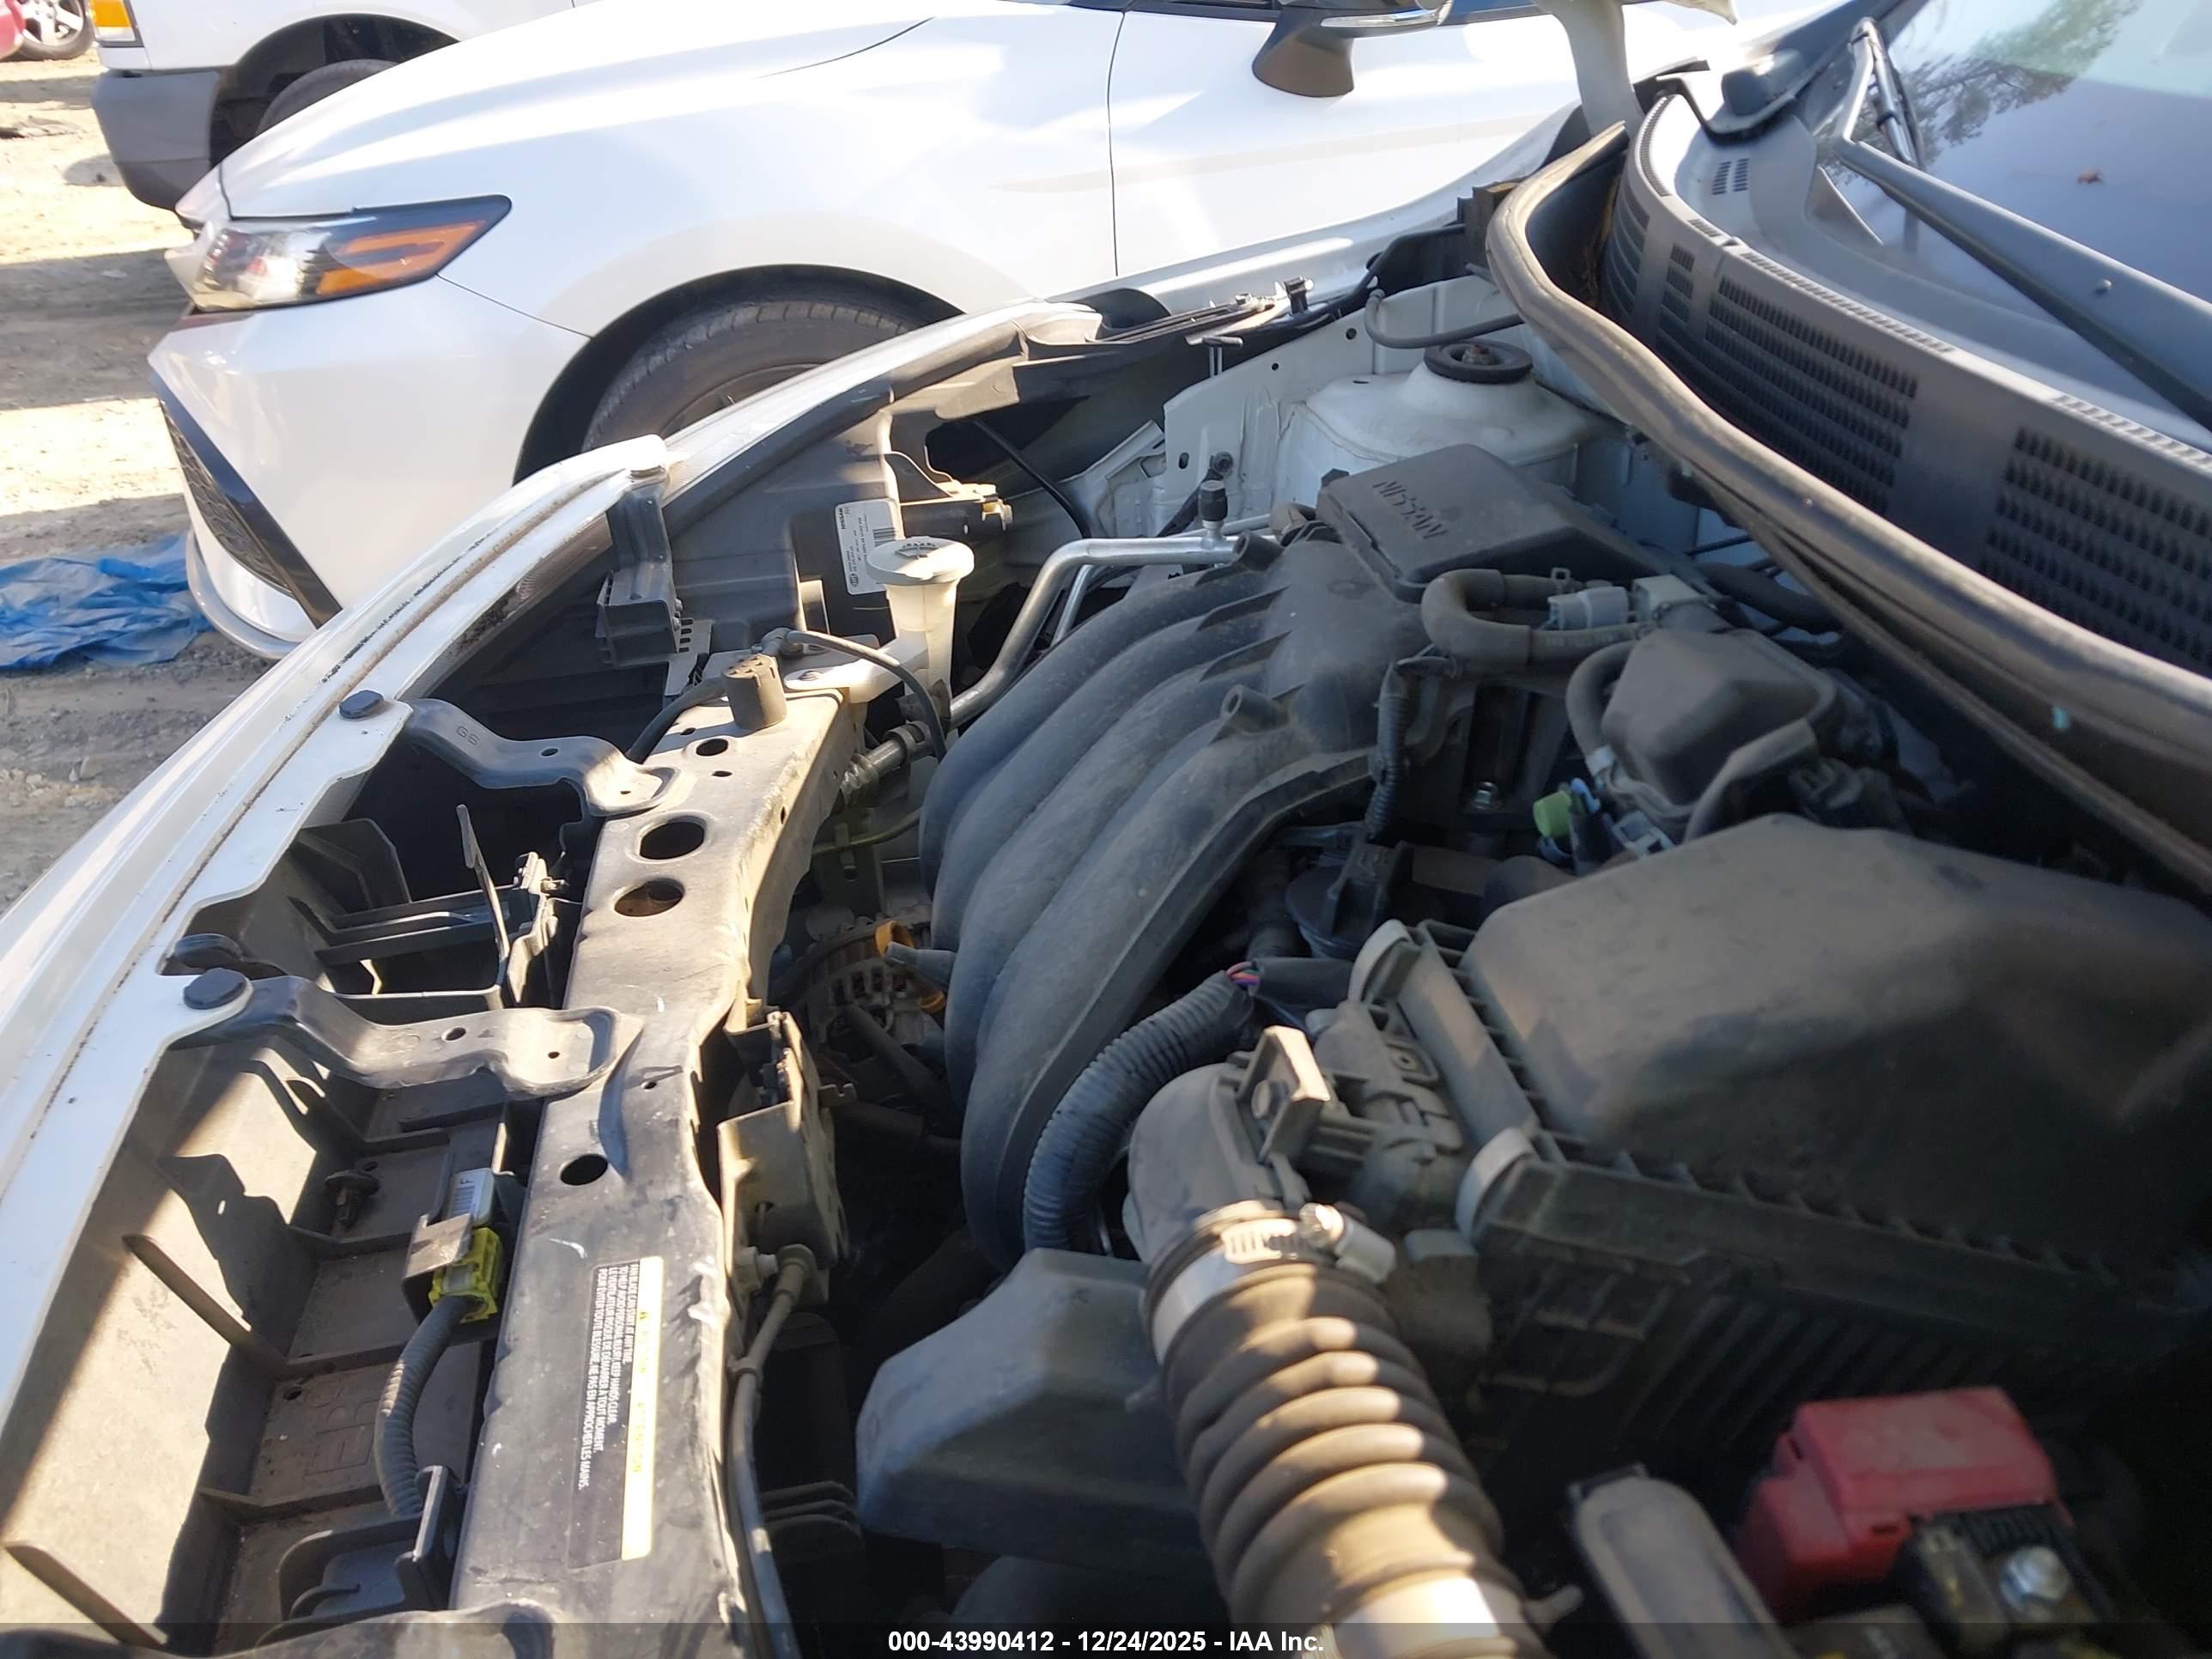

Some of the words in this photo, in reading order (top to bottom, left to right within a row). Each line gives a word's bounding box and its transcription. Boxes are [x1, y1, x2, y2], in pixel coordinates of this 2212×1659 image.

[597, 1269, 608, 1286] POUR
[609, 1267, 617, 1276] LE
[619, 1266, 628, 1274] TO
[617, 1275, 628, 1290] HELP
[605, 1276, 617, 1316] VENTILATEUR
[616, 1290, 626, 1308] AVOID
[628, 1295, 637, 1308] CAN
[592, 1309, 604, 1330] TOUTE
[613, 1309, 625, 1339] PERSONAL
[627, 1309, 635, 1326] START
[603, 1317, 613, 1340] RISQUE
[602, 1341, 611, 1351] DE
[587, 1365, 599, 1376] NE
[611, 1362, 621, 1377] KEEP
[587, 1376, 598, 1389] PAS
[609, 1378, 619, 1401] HANDS
[586, 1389, 596, 1401] EN
[596, 1397, 608, 1415] TOUT
[607, 1401, 618, 1425] CLEAR.
[581, 1401, 595, 1446] APPROCHER
[592, 1417, 605, 1453] MOMENT.
[580, 1446, 592, 1461] LES
[579, 1461, 591, 1490] MAINS.
